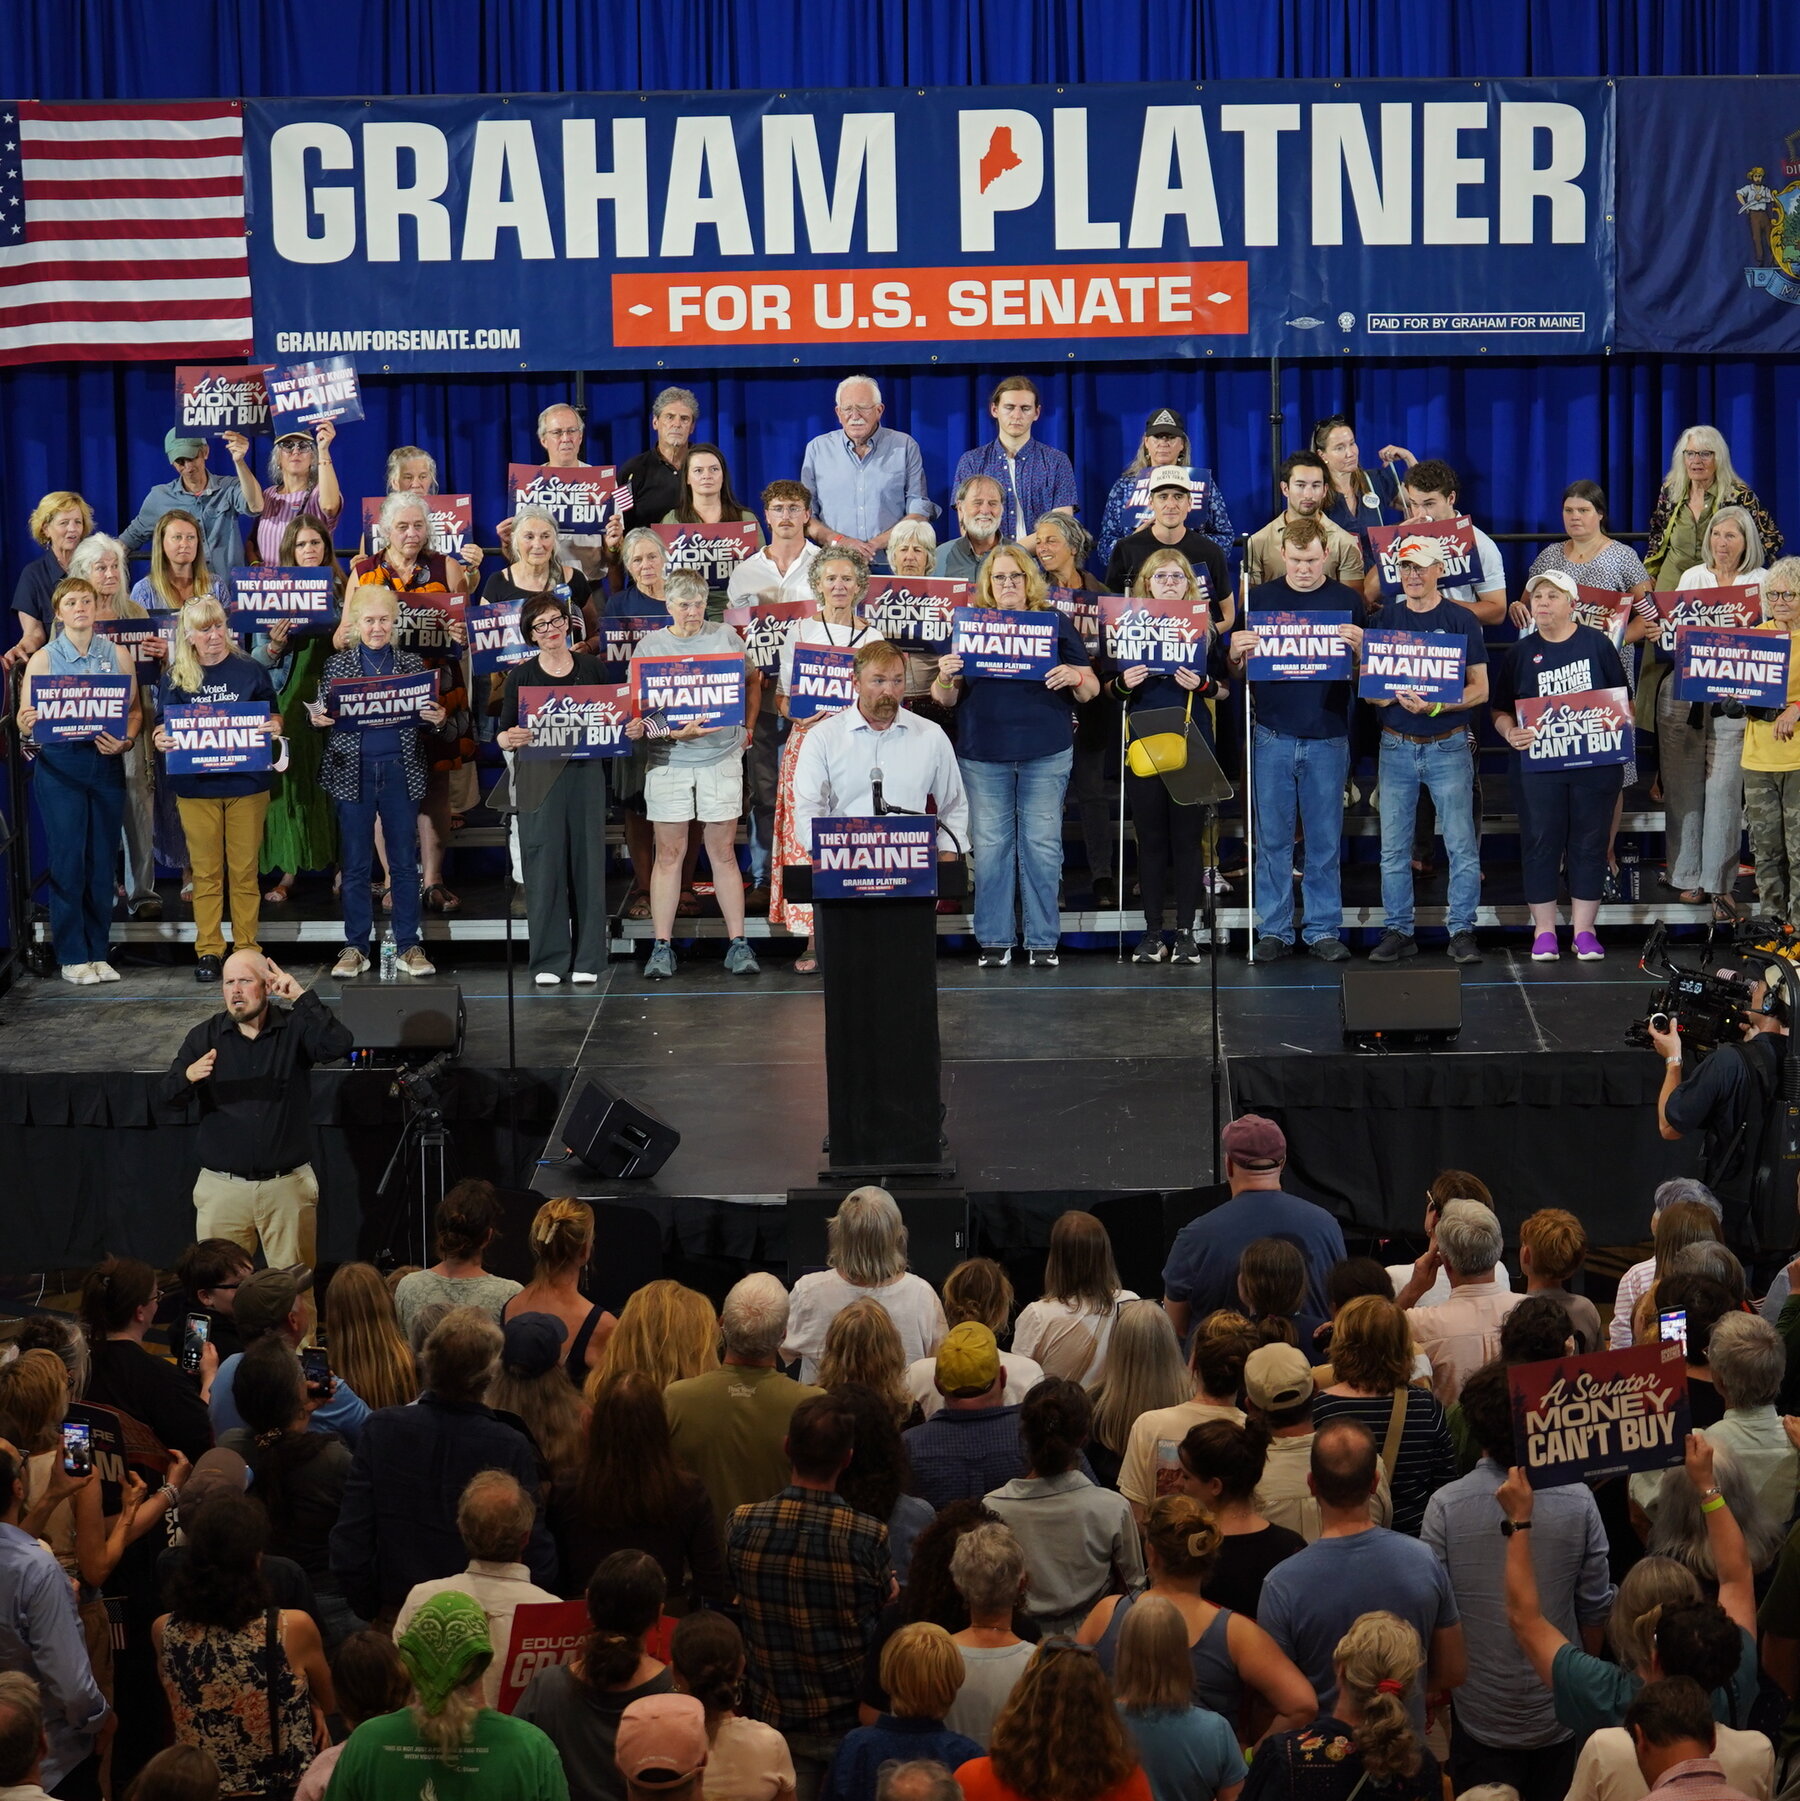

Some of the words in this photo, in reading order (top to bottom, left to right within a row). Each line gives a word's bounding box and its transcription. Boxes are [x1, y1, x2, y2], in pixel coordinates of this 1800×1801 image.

[270, 112, 898, 263] GRAHAM
[959, 102, 1586, 252] PLATNER
[669, 285, 791, 332] FOR
[813, 282, 927, 330] U.S.
[948, 276, 1192, 326] SENATE
[1372, 318, 1400, 329] PAID
[1404, 318, 1429, 328] FOR
[1432, 318, 1448, 328] BY
[1452, 317, 1507, 328] GRAHAM
[1510, 317, 1535, 328] FOR
[1539, 316, 1580, 328] MAINE
[276, 329, 520, 353] GRAHAMFORSENATE.COM
[194, 378, 212, 393] A
[215, 378, 263, 393] Senator
[272, 381, 297, 393] THEY
[298, 375, 325, 388] DON'T
[327, 368, 354, 383] KNOW
[184, 392, 267, 406] MONEY
[276, 379, 357, 412] MAINE
[183, 408, 233, 426] CAN'T
[238, 405, 268, 424] BUY
[526, 477, 544, 490] A
[546, 477, 600, 491] Senator
[516, 489, 607, 505] MONEY
[572, 504, 606, 523] BUY
[669, 534, 687, 549] A
[689, 534, 742, 548] Senator
[236, 581, 261, 590] THEY
[263, 580, 292, 589] DON'T
[295, 580, 327, 589] KNOW
[238, 592, 327, 610] MAINE
[875, 589, 892, 605] A
[896, 589, 951, 607] Senator
[1057, 601, 1086, 613] DON'T
[865, 604, 954, 622] MONEY
[1115, 610, 1132, 625] A
[1135, 609, 1191, 627] Senator
[1669, 602, 1686, 618] A
[1689, 600, 1745, 616] Senator
[472, 618, 495, 630] THEY
[743, 618, 760, 634] A
[959, 621, 983, 632] THEY
[986, 623, 1017, 634] DON'T
[1019, 625, 1052, 636] KNOW
[1253, 625, 1278, 635] THEY
[1281, 625, 1310, 635] DON'T
[605, 631, 630, 640] THEY
[1106, 625, 1198, 642] MONEY
[959, 634, 1051, 657] MAINE
[1107, 640, 1157, 660] CAN'T
[1162, 642, 1197, 662] BUY
[1254, 638, 1345, 656] MAINE
[1368, 643, 1393, 654] THEY
[1396, 644, 1425, 656] DON'T
[1428, 647, 1461, 658] KNOW
[1691, 645, 1716, 657] THEY
[1718, 647, 1749, 659] DON'T
[1752, 650, 1785, 663] KNOW
[800, 663, 825, 675] THEY
[1368, 656, 1459, 679] MAINE
[1538, 659, 1589, 685] GRAHAM
[1690, 658, 1782, 684] MAINE
[646, 676, 672, 687] THEY
[674, 675, 704, 685] DON'T
[707, 672, 739, 684] KNOW
[1539, 671, 1591, 697] PLATNER
[36, 689, 61, 699] THEY
[63, 688, 91, 697] DON'T
[93, 688, 125, 697] KNOW
[203, 684, 227, 694] Voted
[213, 692, 239, 702] Likely
[339, 693, 363, 702] THEY
[367, 690, 396, 699] DON'T
[399, 684, 430, 696] KNOW
[649, 685, 739, 707] MAINE
[37, 700, 123, 719] MAINE
[340, 695, 430, 716] MAINE
[538, 698, 556, 714] A
[559, 697, 616, 713] Senator
[170, 719, 195, 729] THEY
[198, 717, 229, 727] DON'T
[232, 716, 264, 726] KNOW
[528, 711, 623, 728] MONEY
[1537, 708, 1554, 725] A
[1557, 705, 1613, 722] Senator
[528, 726, 581, 746] CAN'T
[587, 725, 623, 745] BUY
[1528, 716, 1621, 739] MONEY
[172, 729, 265, 750] MAINE
[1529, 735, 1582, 759] CAN'T
[1587, 730, 1623, 753] BUY
[819, 834, 848, 845] THEY
[851, 833, 887, 844] DON'T
[890, 832, 929, 843] KNOW
[821, 846, 928, 869] MAINE
[1540, 1378, 1568, 1409] A
[1572, 1373, 1661, 1401] Senator
[1526, 1388, 1673, 1434] MONEY
[1528, 1423, 1610, 1467] CAN'T
[1620, 1412, 1675, 1452] BUY
